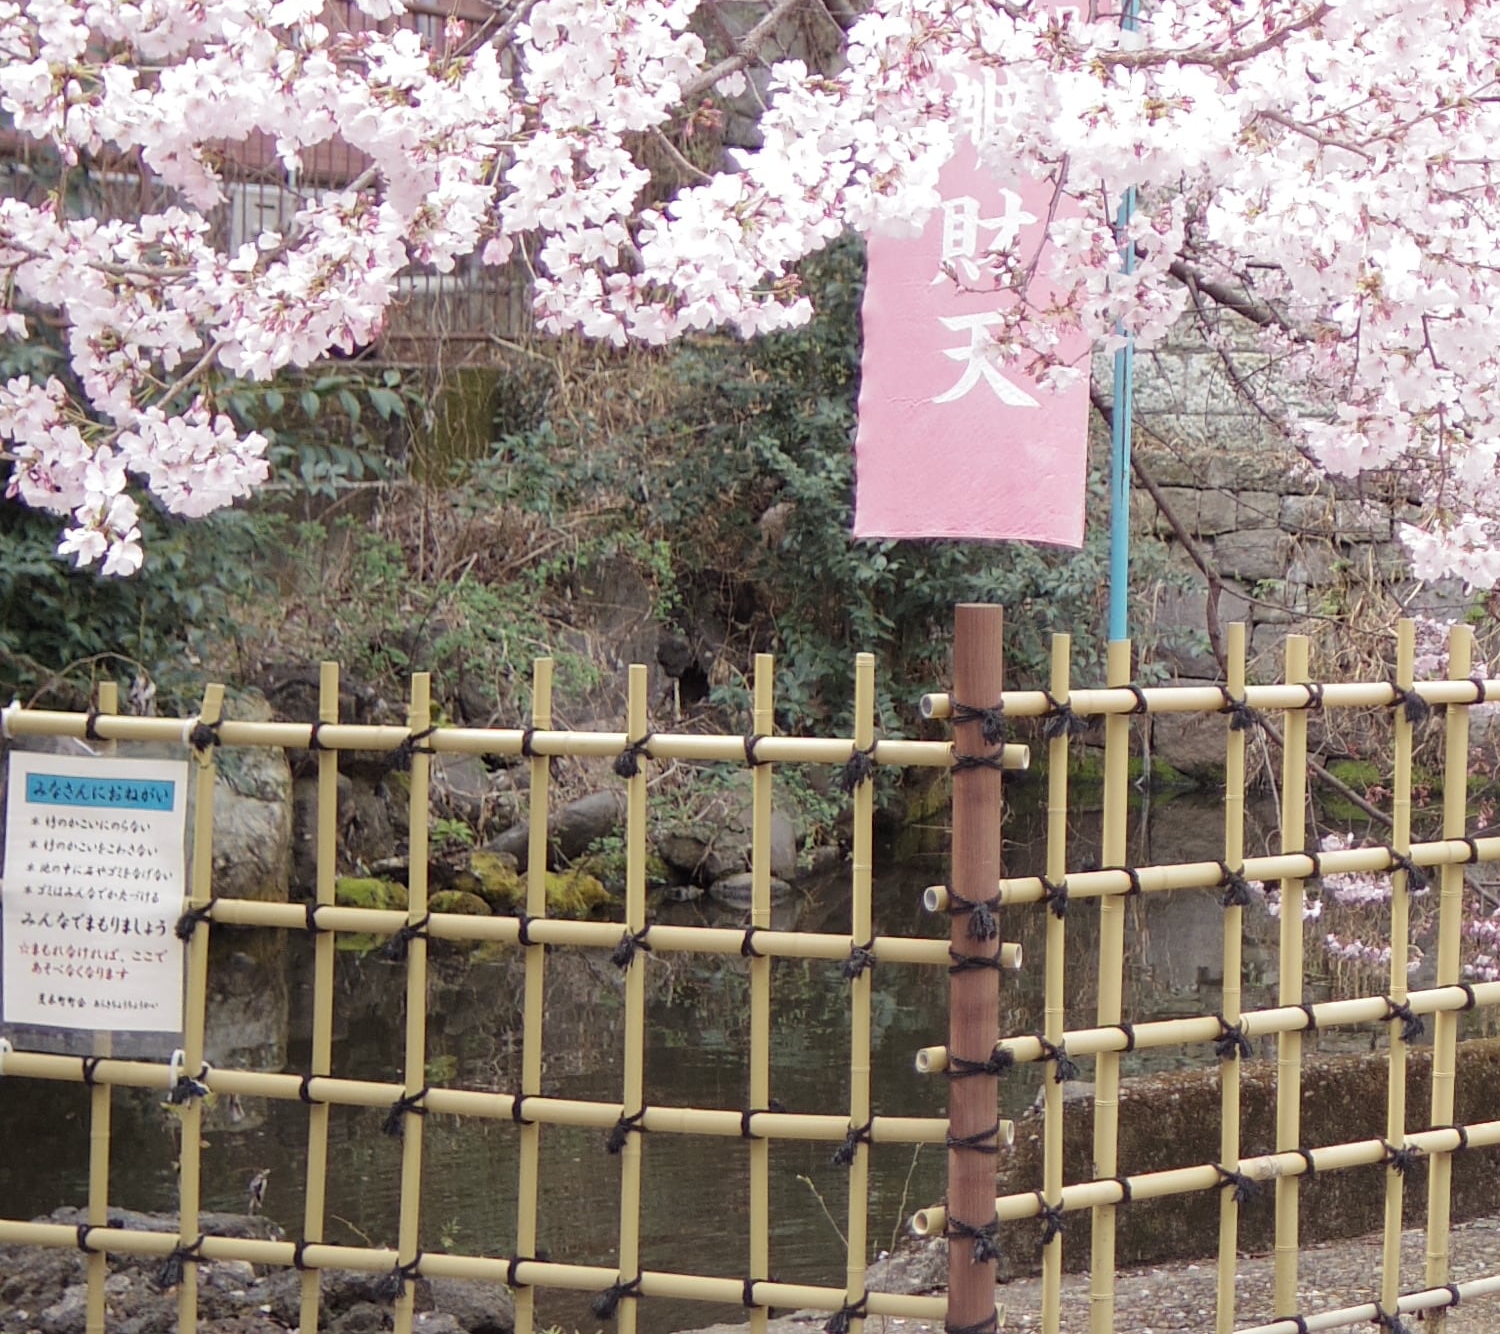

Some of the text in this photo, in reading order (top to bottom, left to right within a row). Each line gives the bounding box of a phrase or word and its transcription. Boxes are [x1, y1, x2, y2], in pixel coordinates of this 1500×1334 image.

[33, 780, 169, 803] みなさんにおねがい
[20, 911, 168, 936] みんなでまもりましょう
[31, 961, 129, 980] あそべなくなります
